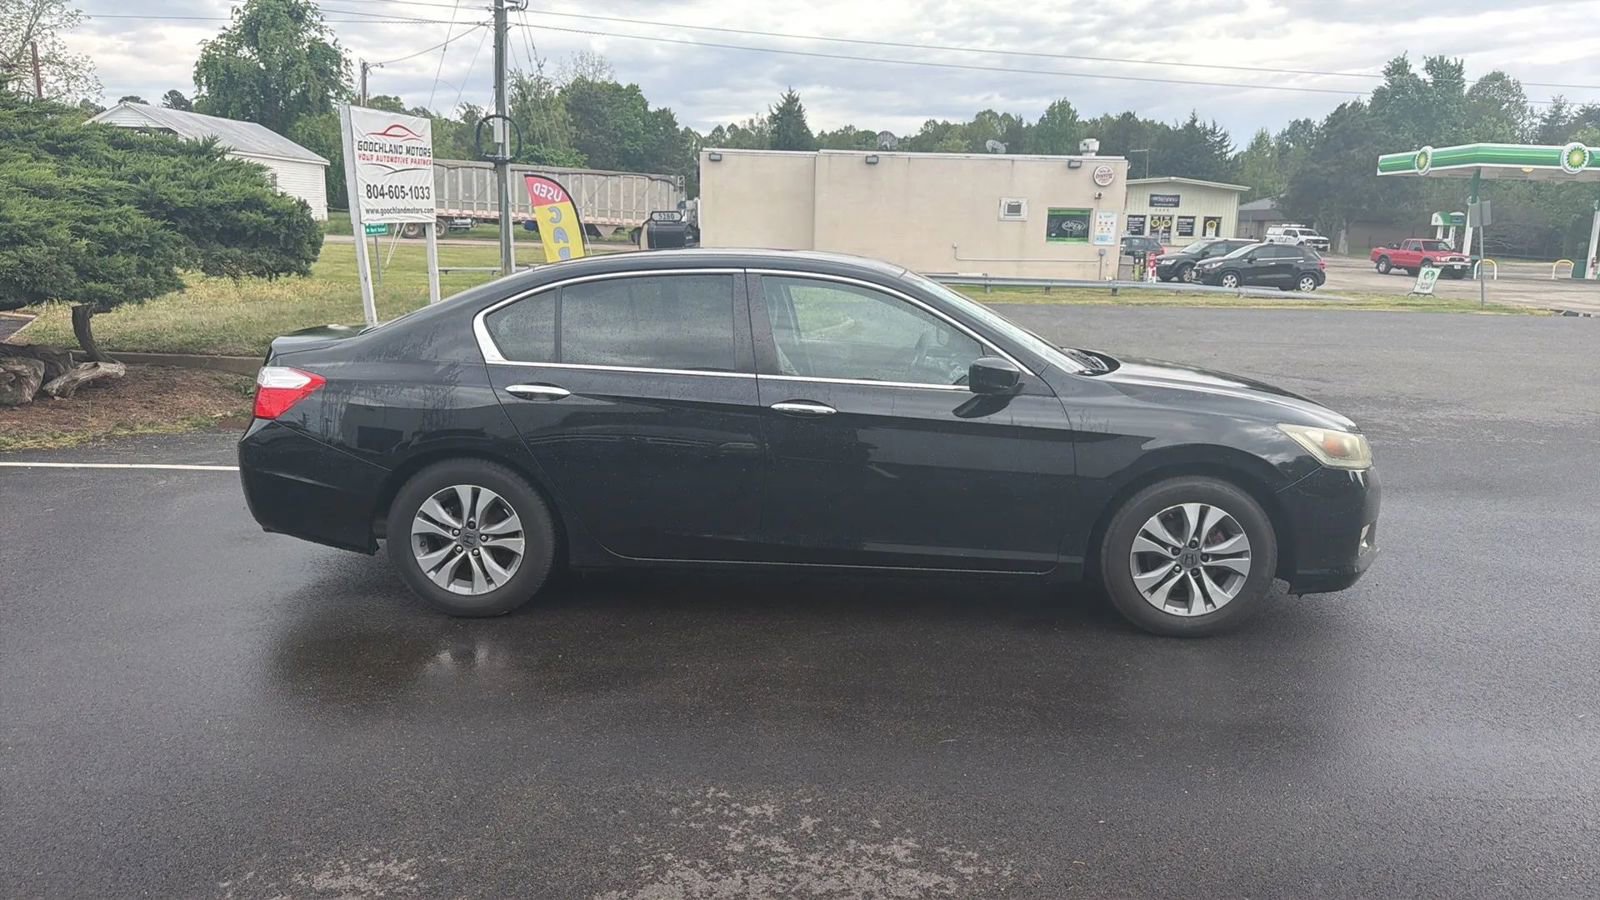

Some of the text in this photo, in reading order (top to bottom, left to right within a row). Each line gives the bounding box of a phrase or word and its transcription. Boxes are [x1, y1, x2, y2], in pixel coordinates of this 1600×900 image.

[358, 141, 431, 157] GOOCHLAND MOTORS
[358, 153, 373, 161] YOUR
[376, 155, 408, 164] AUTOMOTIVE
[366, 184, 430, 200] 804-605-1033
[365, 206, 434, 216] www.goochlandmotors.com
[1063, 221, 1083, 231] OPEN
